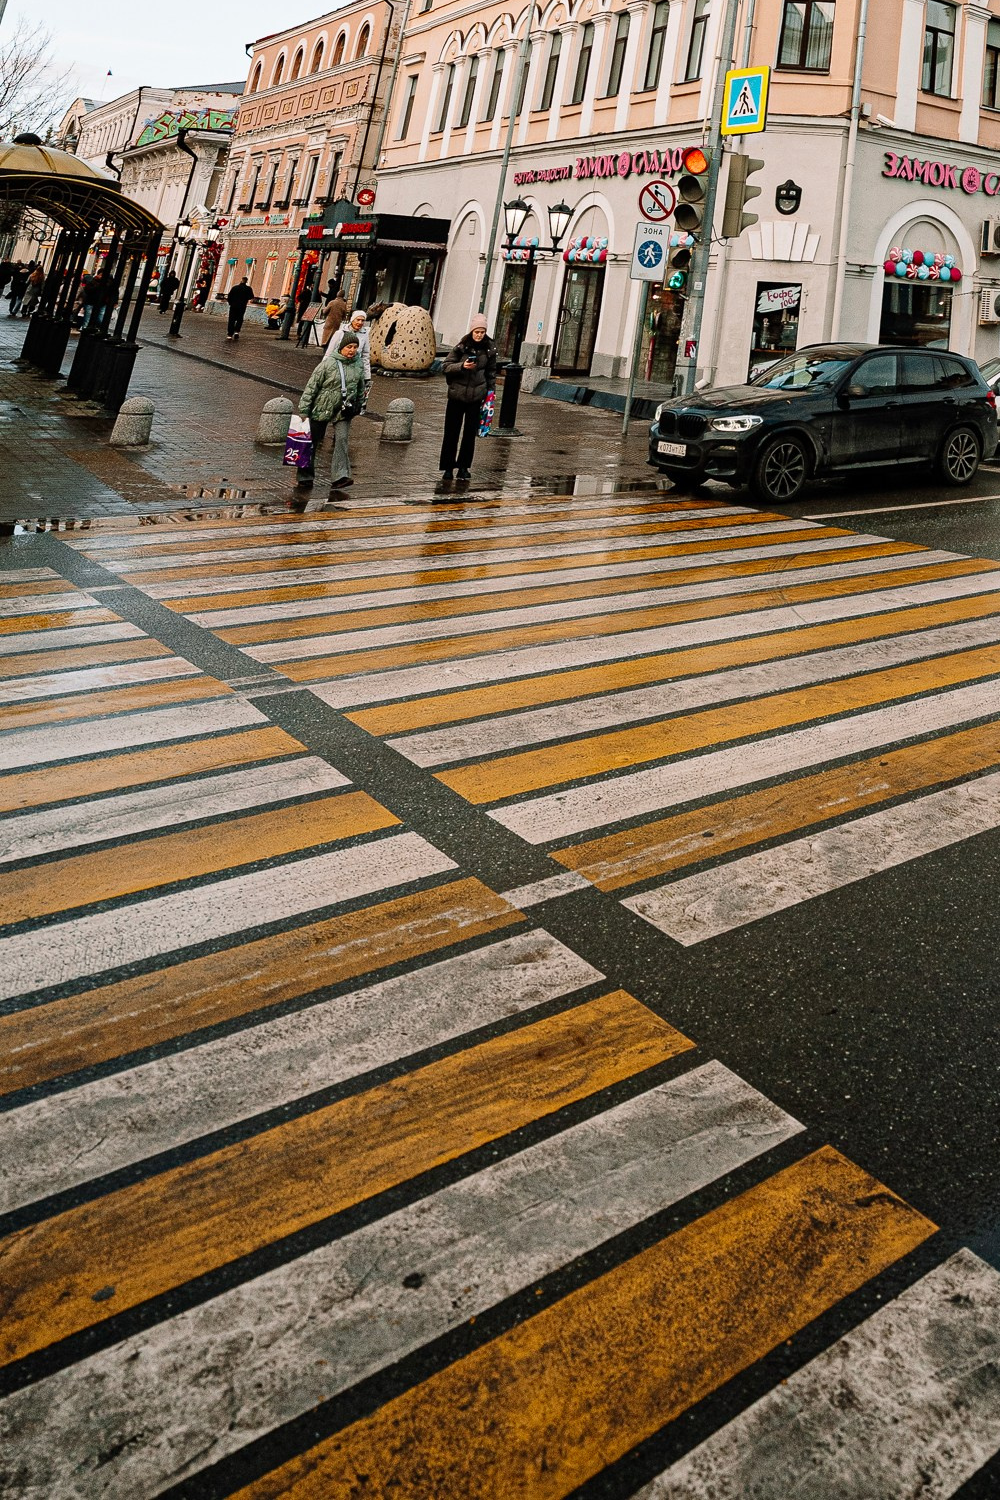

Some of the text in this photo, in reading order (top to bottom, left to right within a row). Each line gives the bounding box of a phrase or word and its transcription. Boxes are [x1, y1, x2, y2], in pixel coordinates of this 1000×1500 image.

[573, 147, 685, 179] ЗАМОК СЛАДО
[883, 151, 958, 189] ЗАМОК
[643, 227, 663, 236] ЗОНА
